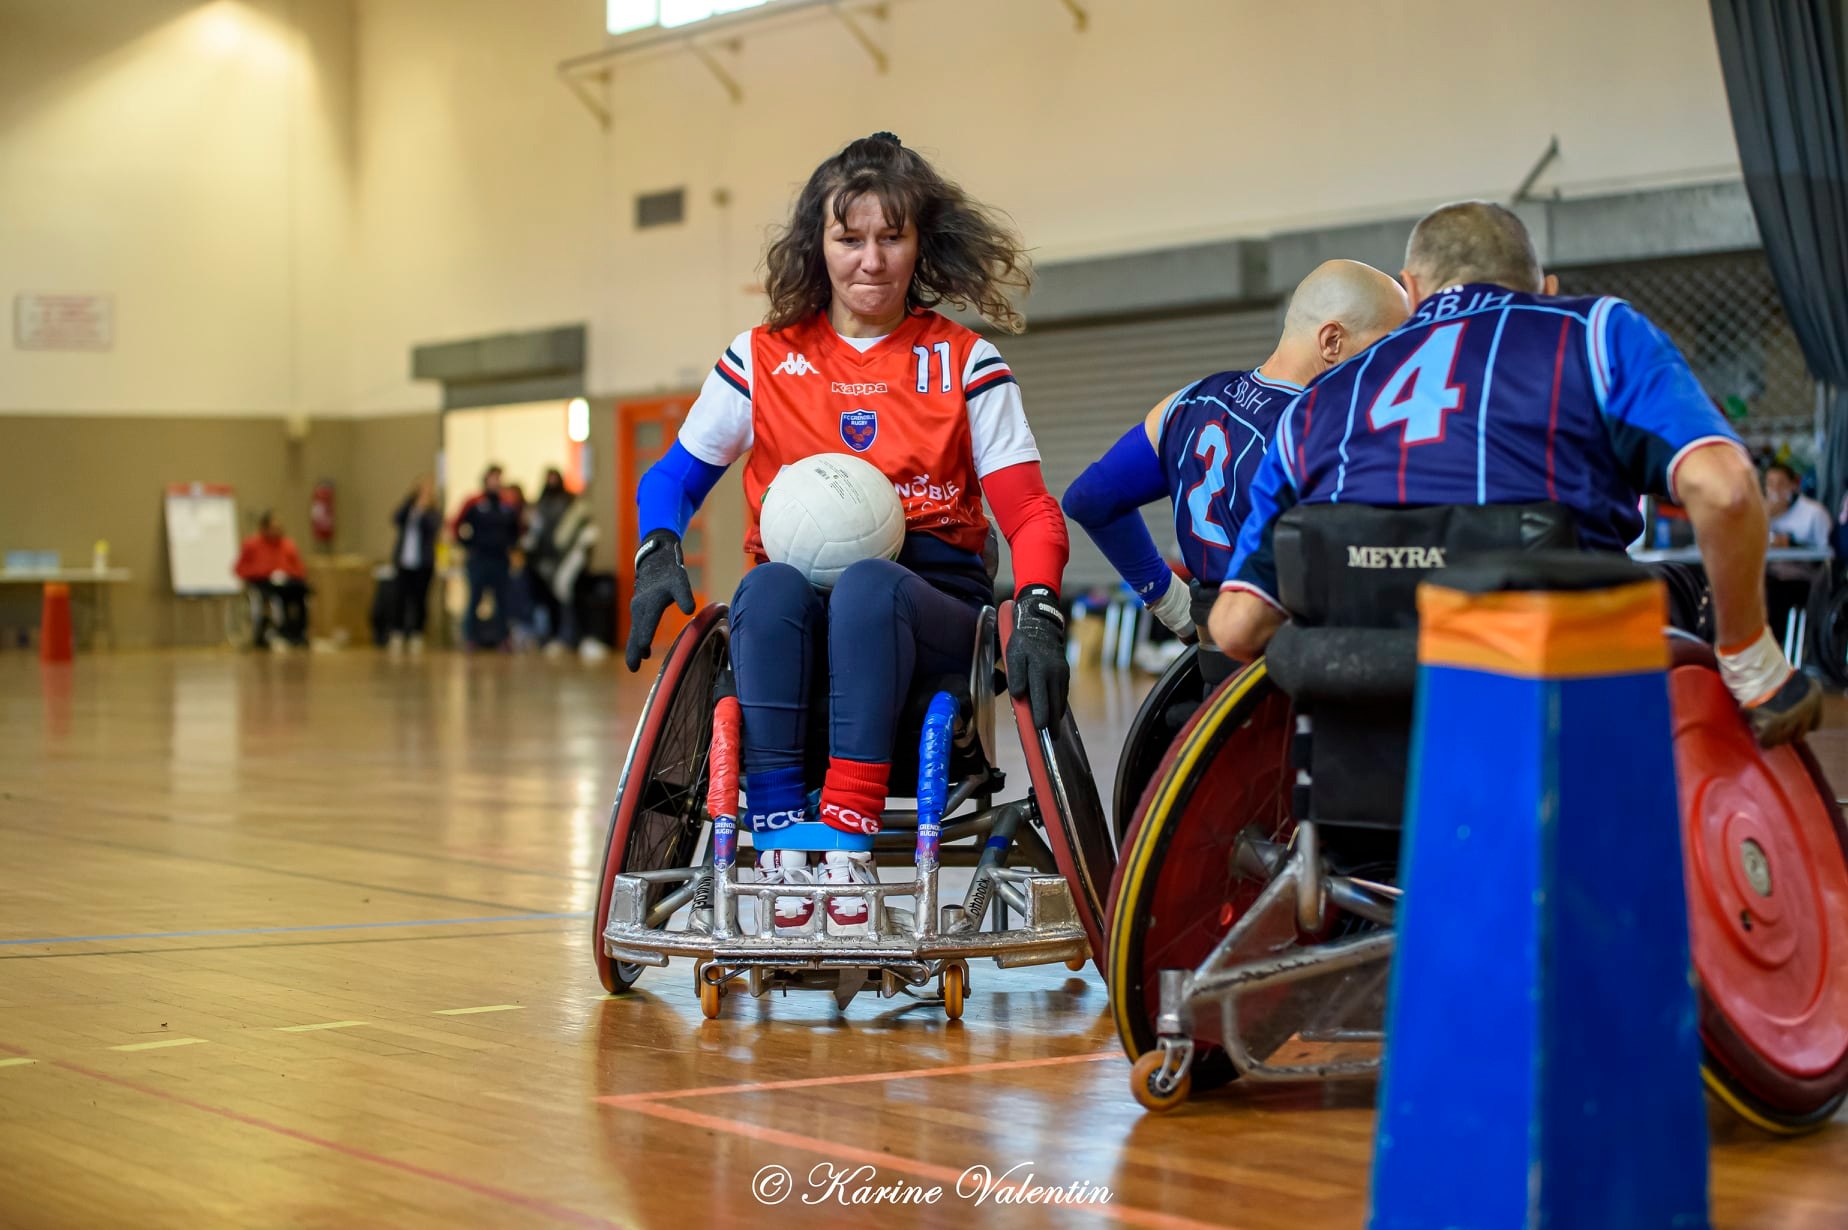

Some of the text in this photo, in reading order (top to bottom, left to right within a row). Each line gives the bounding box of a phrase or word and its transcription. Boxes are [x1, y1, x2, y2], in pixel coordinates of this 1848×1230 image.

[1416, 292, 1514, 325] SBJH
[912, 339, 952, 394] 11
[831, 381, 888, 396] Kappa
[1367, 319, 1467, 448] 4
[1187, 419, 1234, 551] 2
[1347, 545, 1446, 569] MEYRA
[822, 803, 879, 836] FCG
